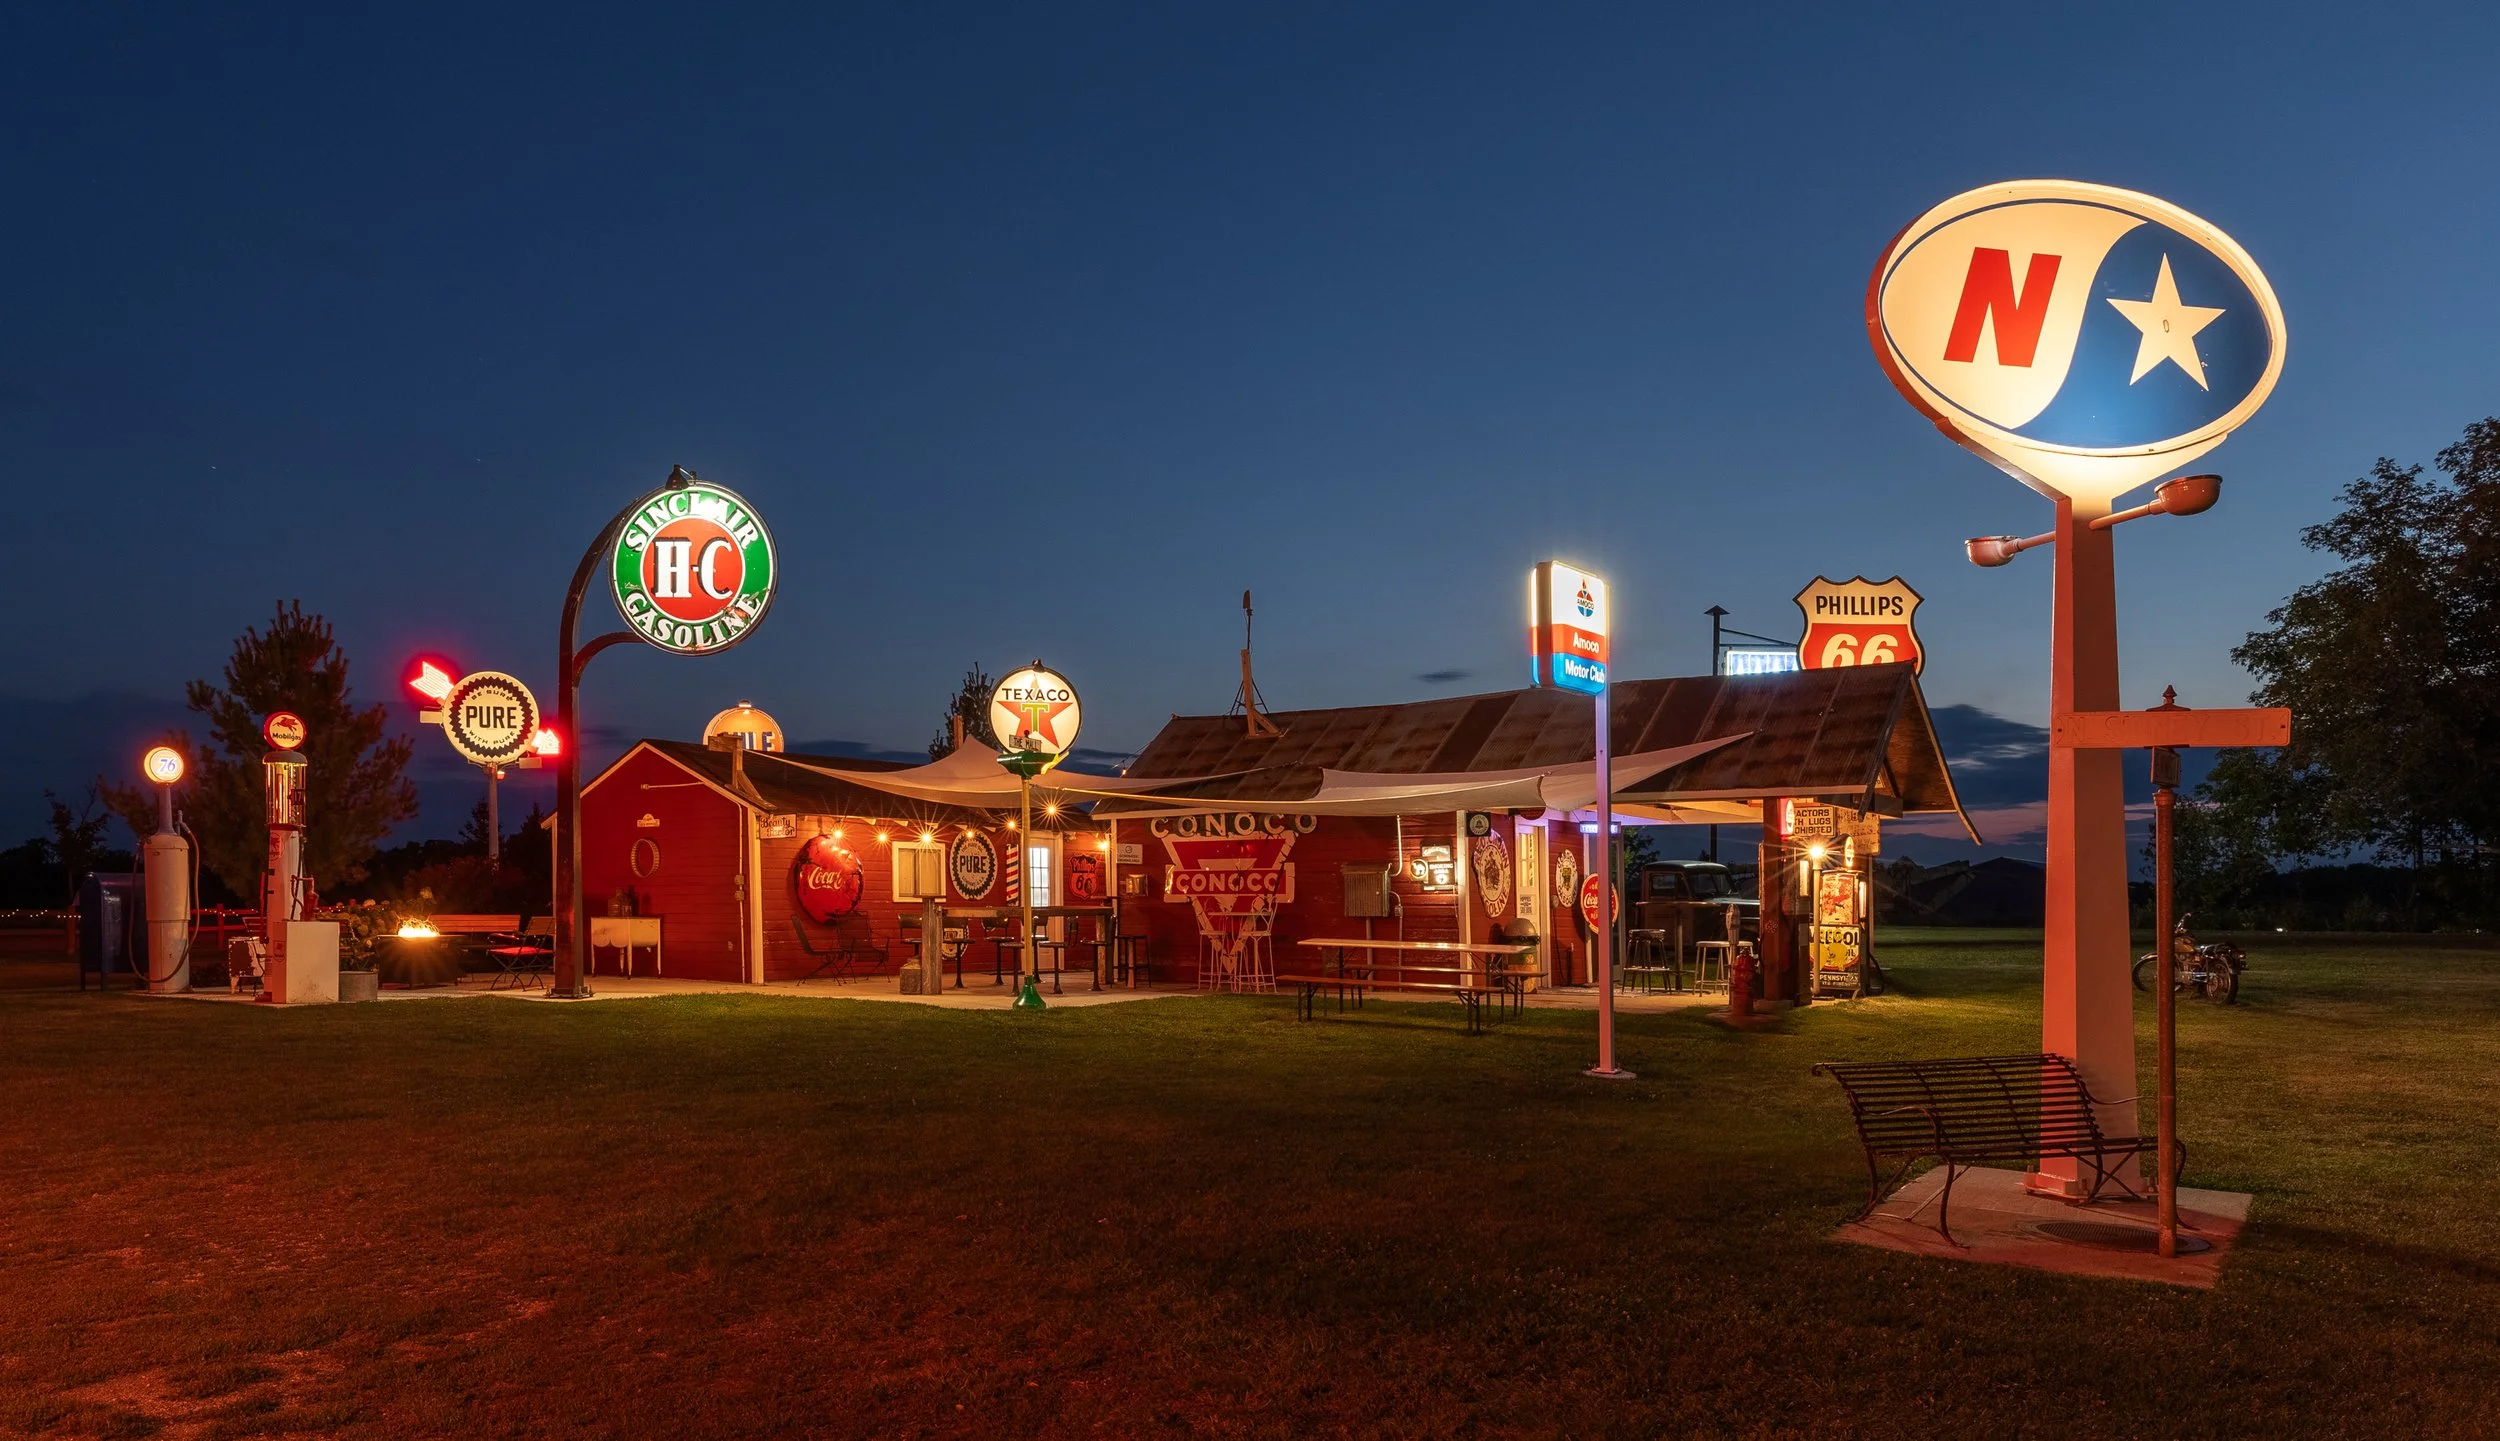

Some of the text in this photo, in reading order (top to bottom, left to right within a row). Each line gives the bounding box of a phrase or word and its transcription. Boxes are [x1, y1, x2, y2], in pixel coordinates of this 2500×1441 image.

[1943, 246, 2062, 368] N
[624, 491, 760, 552] SINCLAIR
[1577, 598, 1594, 610] AMOCO
[1816, 595, 1904, 616] PHILLIPS
[625, 591, 761, 648] GASOLINE
[1573, 631, 1600, 654] Amoco
[1821, 633, 1899, 669] 66
[1565, 658, 1605, 684] Motor Club
[1002, 688, 1070, 702] TEXACO
[465, 705, 518, 729] PURE
[272, 732, 302, 742] Mobilgas
[159, 758, 176, 773] 76
[1795, 808, 1830, 818] ACTORS
[1808, 818, 1831, 826] LUGS
[1150, 812, 1318, 838] CONOCO
[1794, 826, 1832, 834] OHIBITED
[960, 855, 988, 874] PURE
[1075, 874, 1094, 894] 66
[1176, 871, 1282, 892] CONOCO
